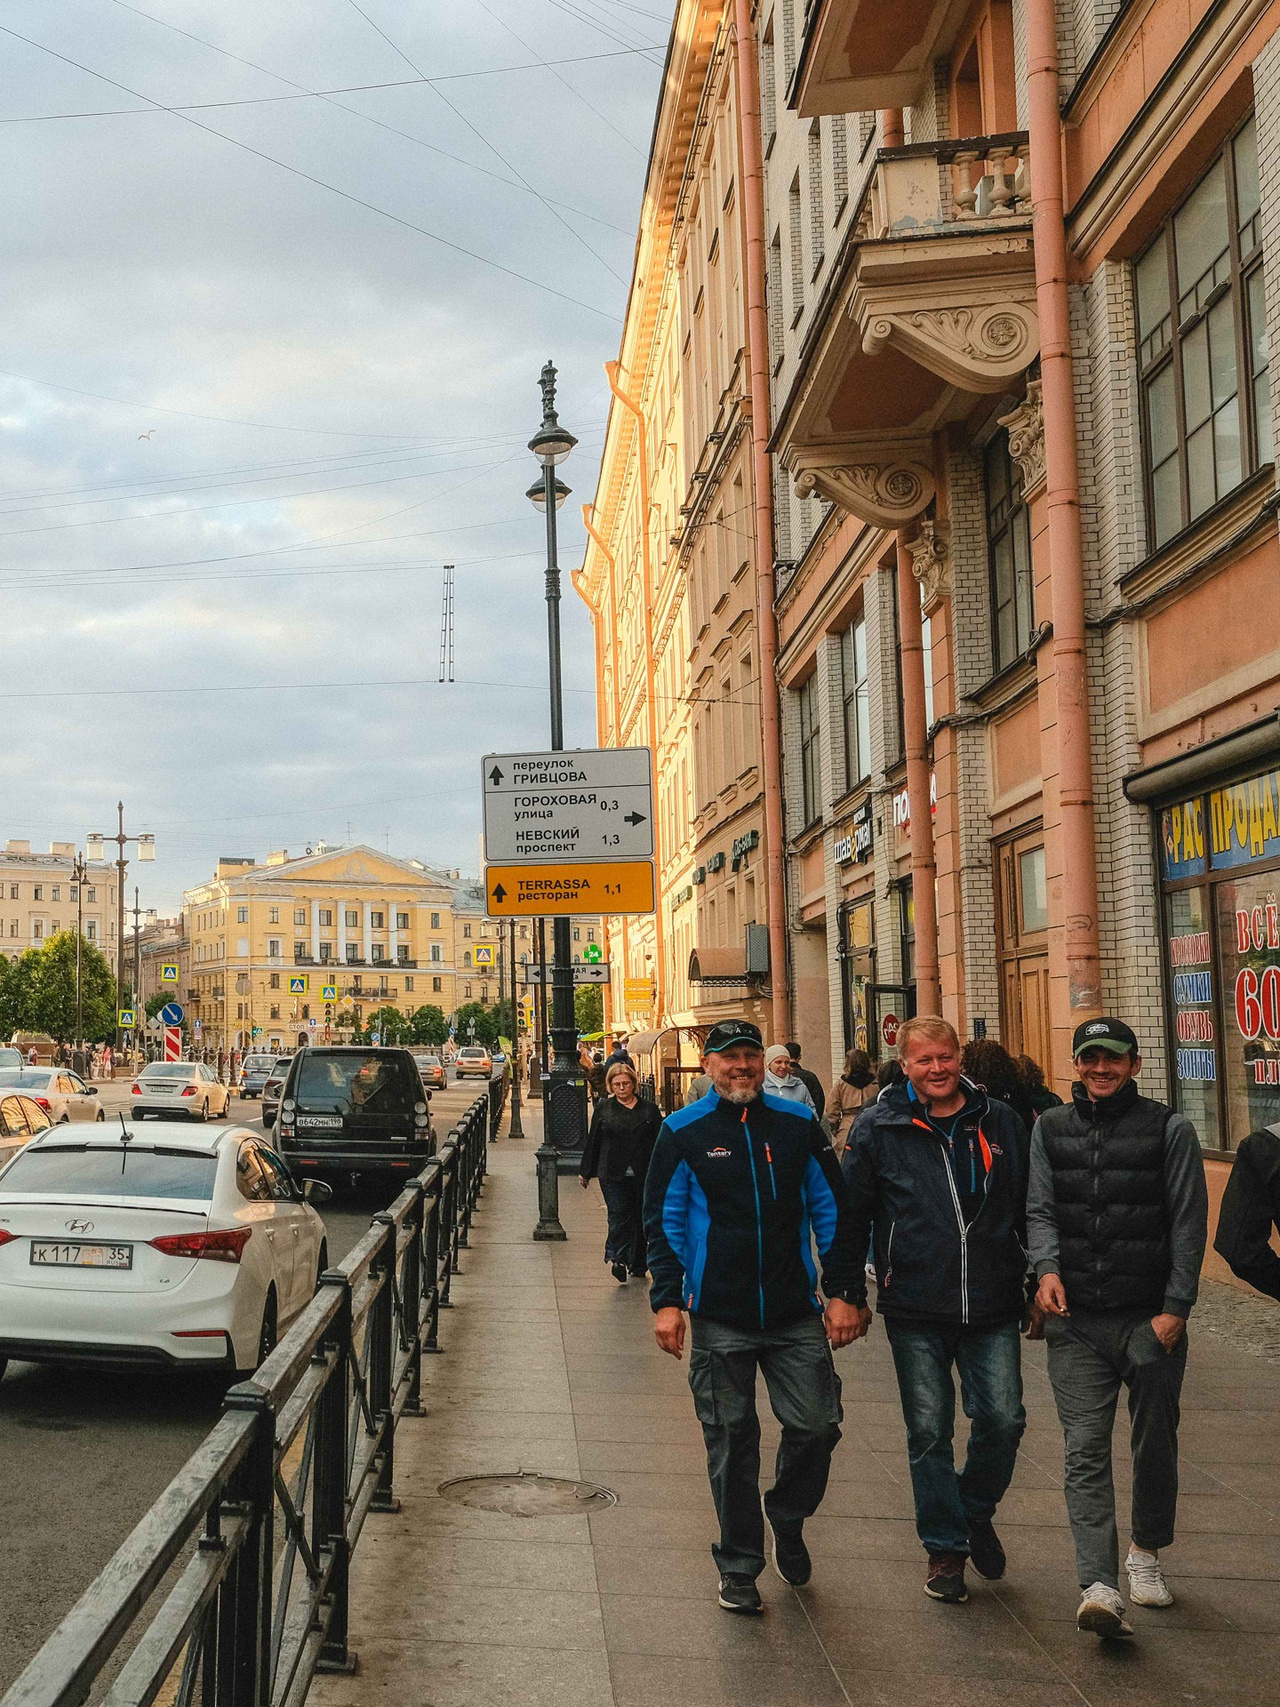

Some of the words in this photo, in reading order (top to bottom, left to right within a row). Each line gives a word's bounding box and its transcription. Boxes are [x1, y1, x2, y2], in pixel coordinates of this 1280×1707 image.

[513, 760, 574, 771] переулок
[513, 771, 587, 785] ГРИВЦОВА
[514, 794, 597, 807] ГОРОХОВАЯ
[600, 800, 619, 812] 0,3
[514, 809, 553, 821] улица
[1210, 770, 1280, 858] ПРОДА
[516, 826, 580, 841] НЕВСКИЙ
[601, 834, 620, 846] 1,3
[516, 843, 576, 854] проспект
[517, 879, 590, 891] TERRASSA
[604, 884, 621, 896] 1,1
[518, 891, 578, 902] ресторан
[1236, 893, 1279, 953] ВСЁ
[1170, 932, 1211, 967] КРОССОВКИ
[1174, 971, 1212, 1005] СУМКИ
[1176, 1010, 1213, 1042] ОБУВЬ
[1177, 1048, 1216, 1081] ЗОНТЫ
[1254, 1059, 1280, 1084] ПЛ
[109, 1247, 125, 1260] 35
